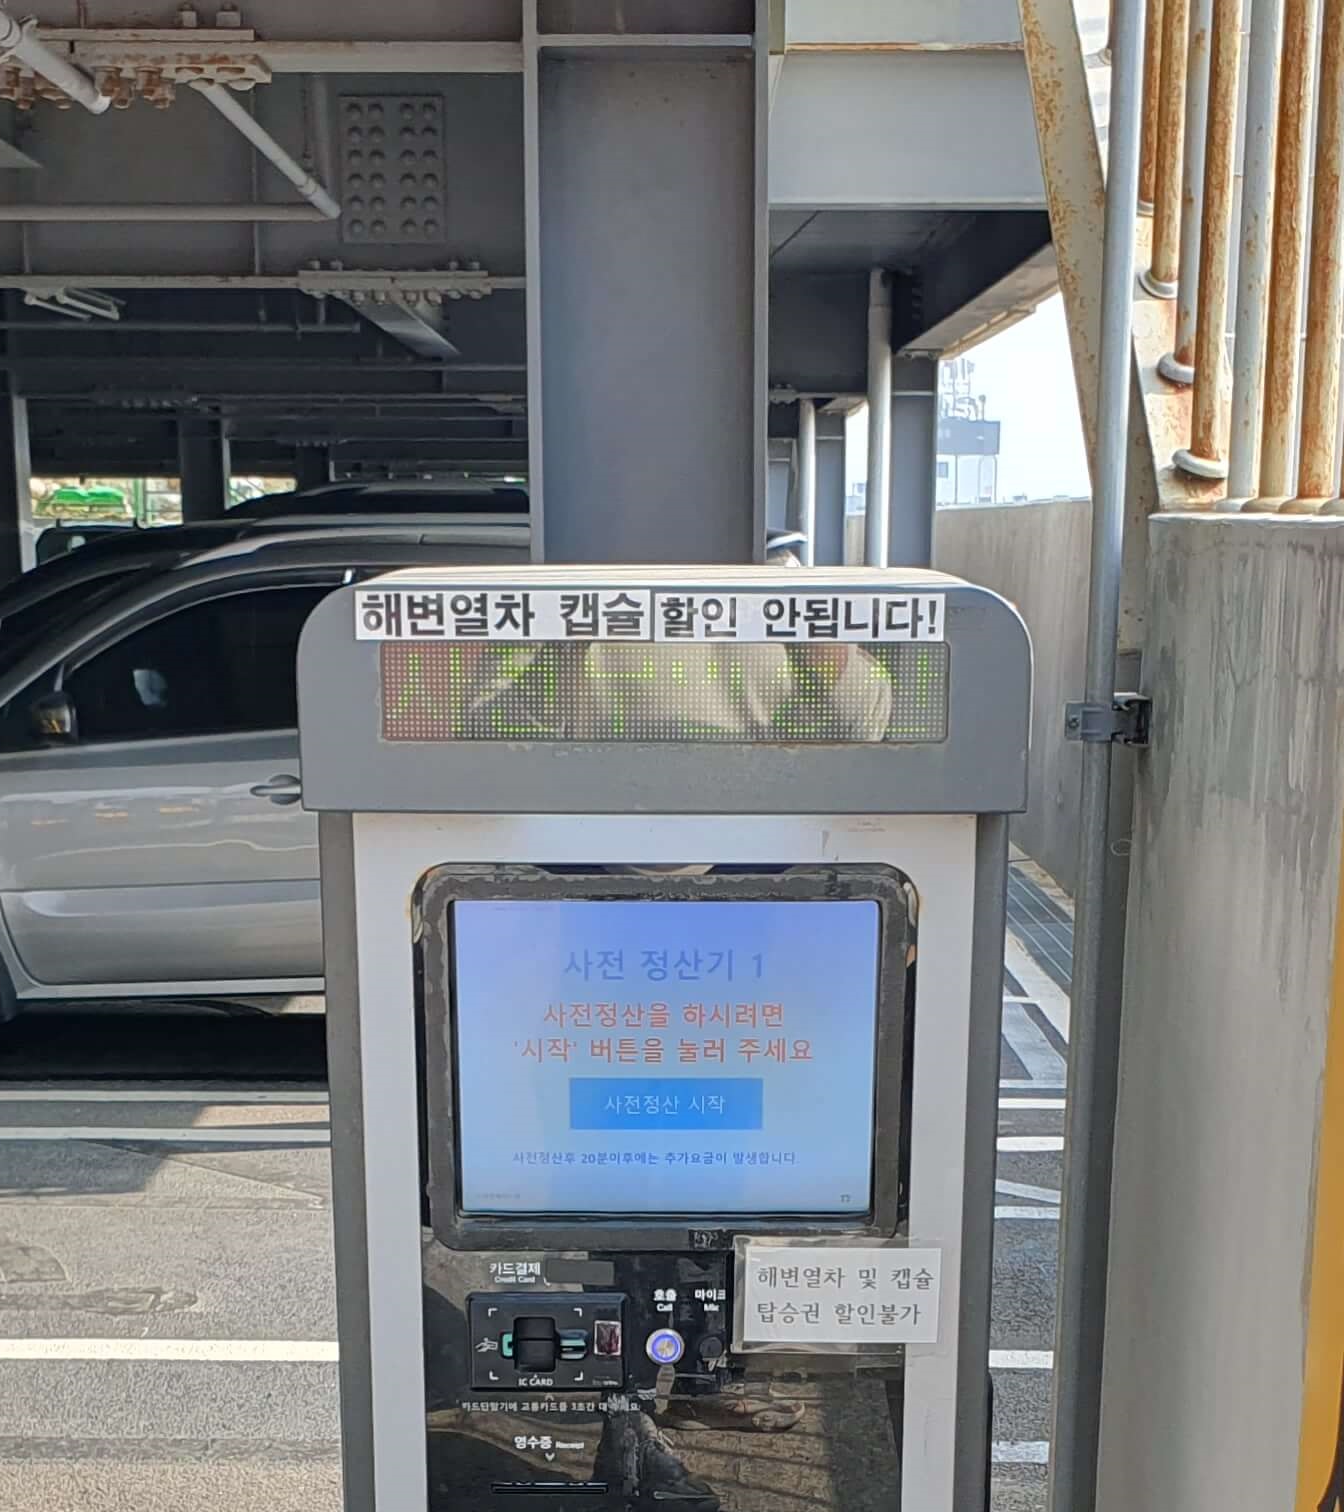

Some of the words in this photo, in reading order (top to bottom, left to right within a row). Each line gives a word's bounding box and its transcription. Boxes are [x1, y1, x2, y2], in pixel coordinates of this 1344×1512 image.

[362, 592, 535, 637] 해변열차
[560, 592, 644, 637] 캡슐
[660, 596, 738, 637] 할인
[763, 597, 937, 637] 안됩니다!
[564, 949, 625, 981] 사전
[640, 949, 735, 982] 정산기
[752, 952, 765, 978] 1
[543, 1002, 670, 1029] 사전정산을
[682, 1002, 785, 1029] 하시려면
[513, 1038, 577, 1064] '시작'
[590, 1038, 665, 1063] 버튼을
[677, 1038, 726, 1063] 눌러
[737, 1038, 814, 1063] 주세요
[605, 1095, 679, 1116] 사전정산
[688, 1095, 726, 1116] 시작
[513, 1152, 576, 1166] 사전정산후
[581, 1152, 659, 1166] 20분이후에는
[664, 1152, 727, 1167] 추가요금이
[490, 1262, 541, 1276] 카드결제
[757, 1267, 846, 1290] 해변열차
[858, 1267, 880, 1289] 및
[889, 1267, 935, 1288] 캡슐
[757, 1302, 821, 1325] 탑승권
[834, 1302, 921, 1325] 할인불가
[518, 1378, 527, 1386] IC
[529, 1378, 554, 1386] CARD
[514, 1435, 552, 1450] 영수증
